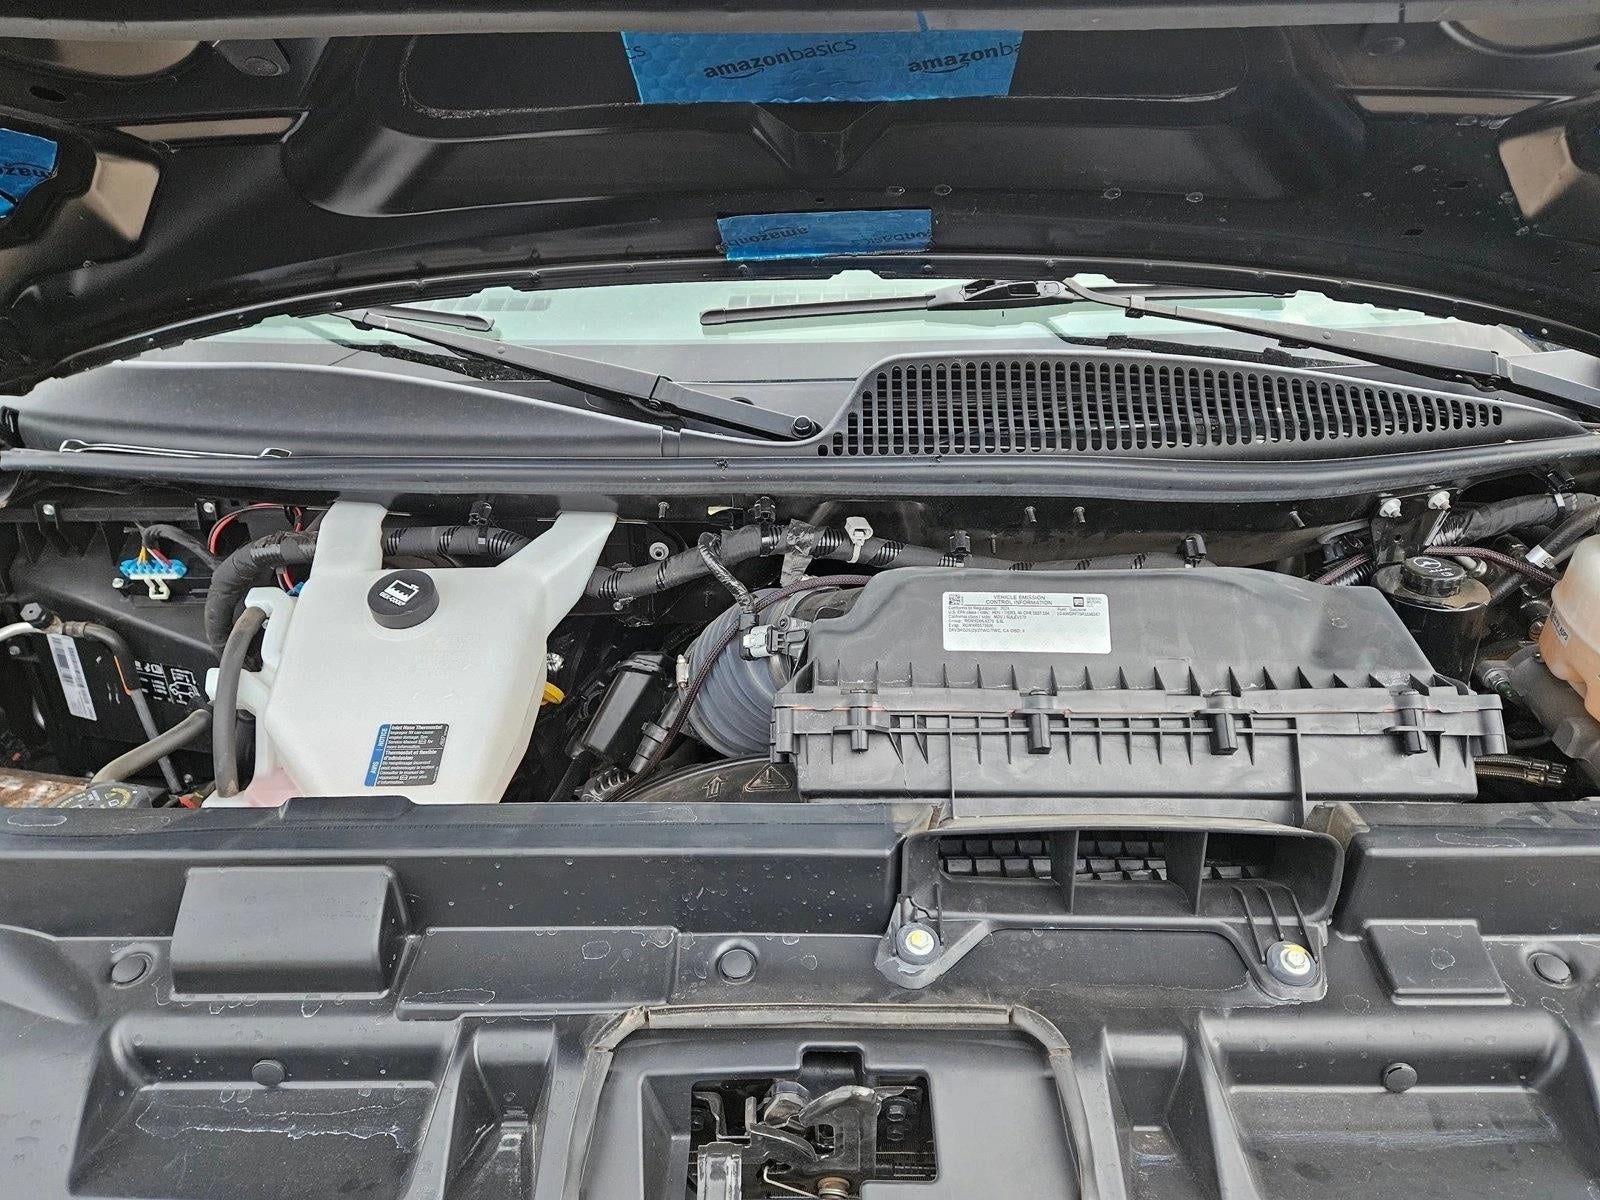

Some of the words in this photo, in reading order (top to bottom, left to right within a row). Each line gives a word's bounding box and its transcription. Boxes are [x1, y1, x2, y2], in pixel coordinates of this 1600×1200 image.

[703, 37, 857, 79] amazonbasics
[379, 728, 388, 746] NOTICE
[370, 761, 379, 774] AVIS
